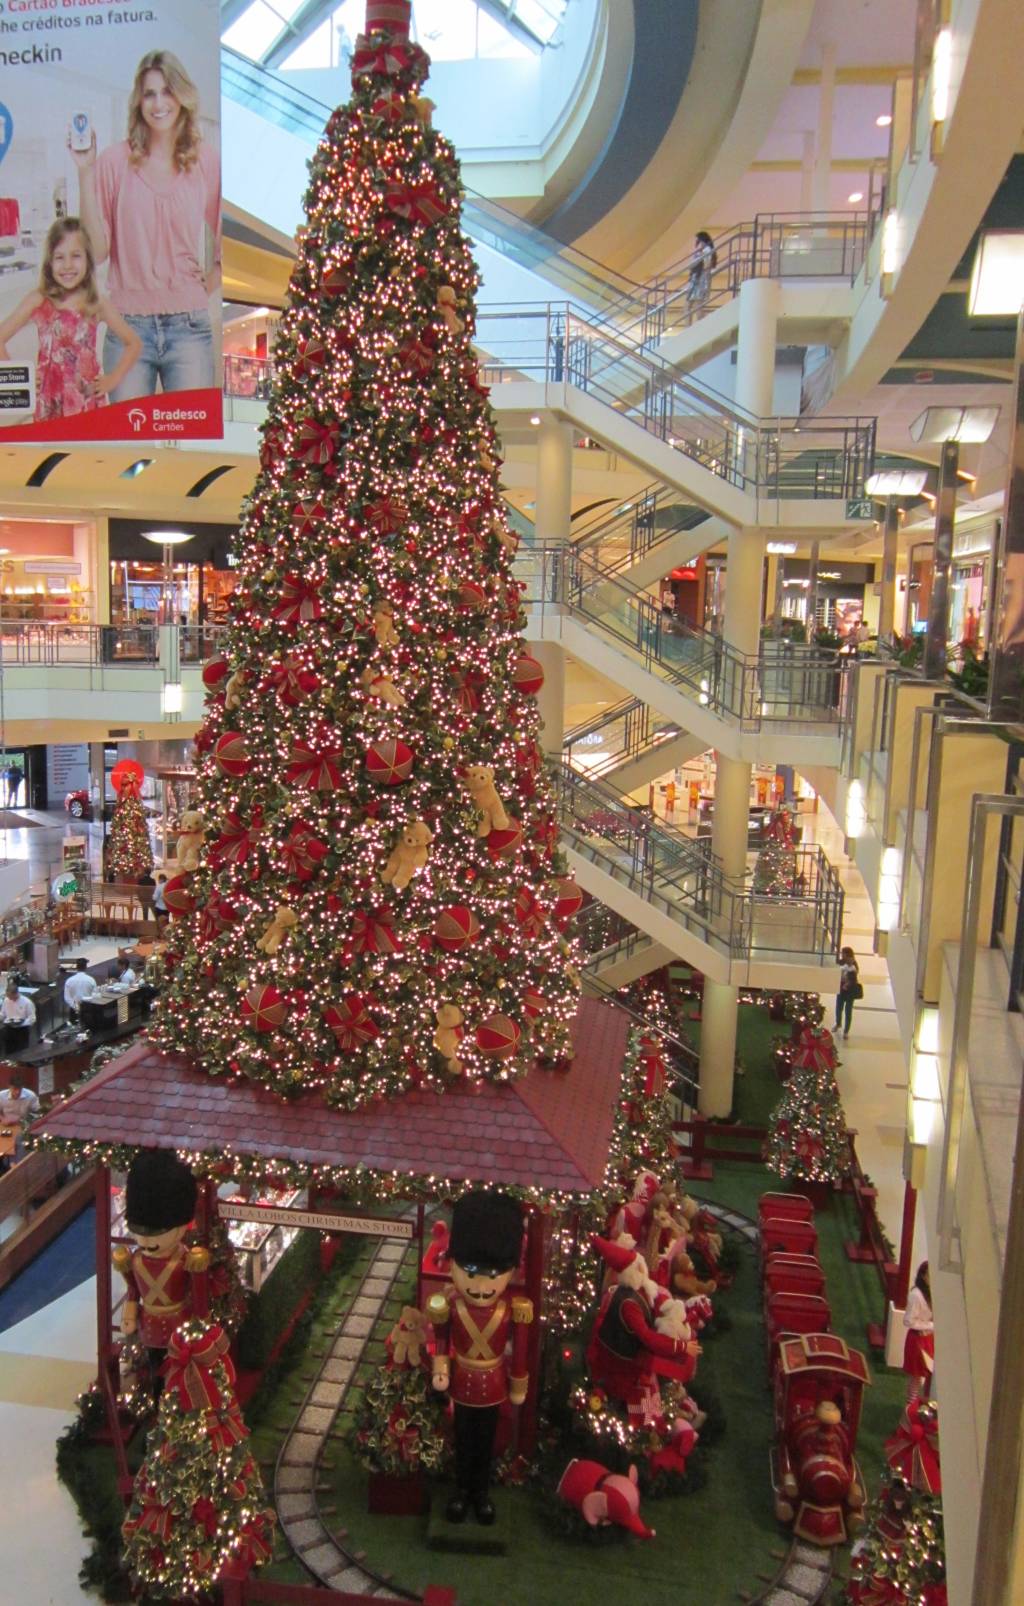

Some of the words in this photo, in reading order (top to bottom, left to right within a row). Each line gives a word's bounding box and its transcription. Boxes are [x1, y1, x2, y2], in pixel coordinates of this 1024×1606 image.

[22, 14, 81, 31] créditos
[85, 14, 104, 26] na
[107, 10, 158, 24] fatura.
[152, 408, 207, 420] Bradesco
[152, 422, 185, 432] Cartões
[219, 1205, 254, 1217] VILLA
[257, 1209, 297, 1222] LOBOS
[298, 1213, 370, 1230] CHRISTMAS
